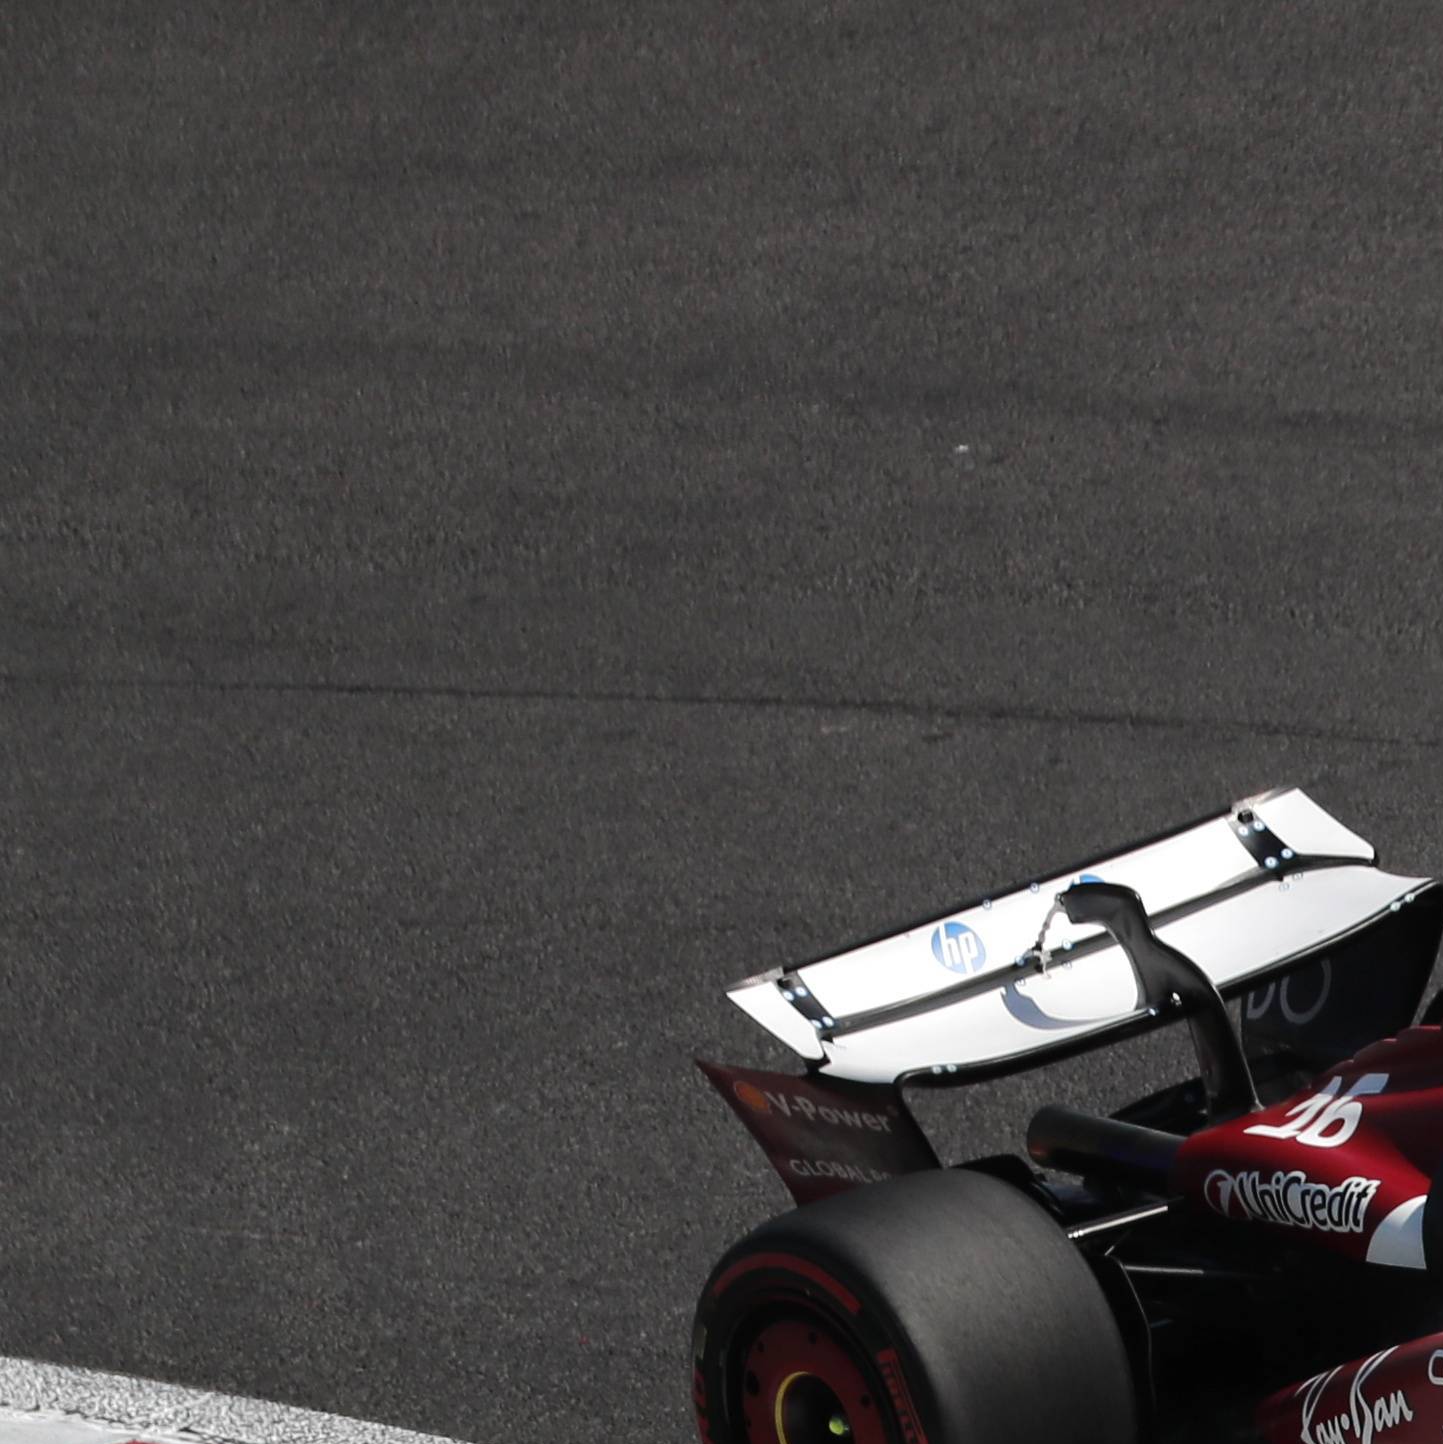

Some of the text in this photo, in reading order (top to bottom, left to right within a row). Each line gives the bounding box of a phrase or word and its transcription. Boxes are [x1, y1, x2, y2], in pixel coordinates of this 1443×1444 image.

[936, 922, 978, 974] hp
[764, 1090, 893, 1134] V-Power
[1243, 1073, 1389, 1148] 16
[1235, 1171, 1382, 1233] UniCredit
